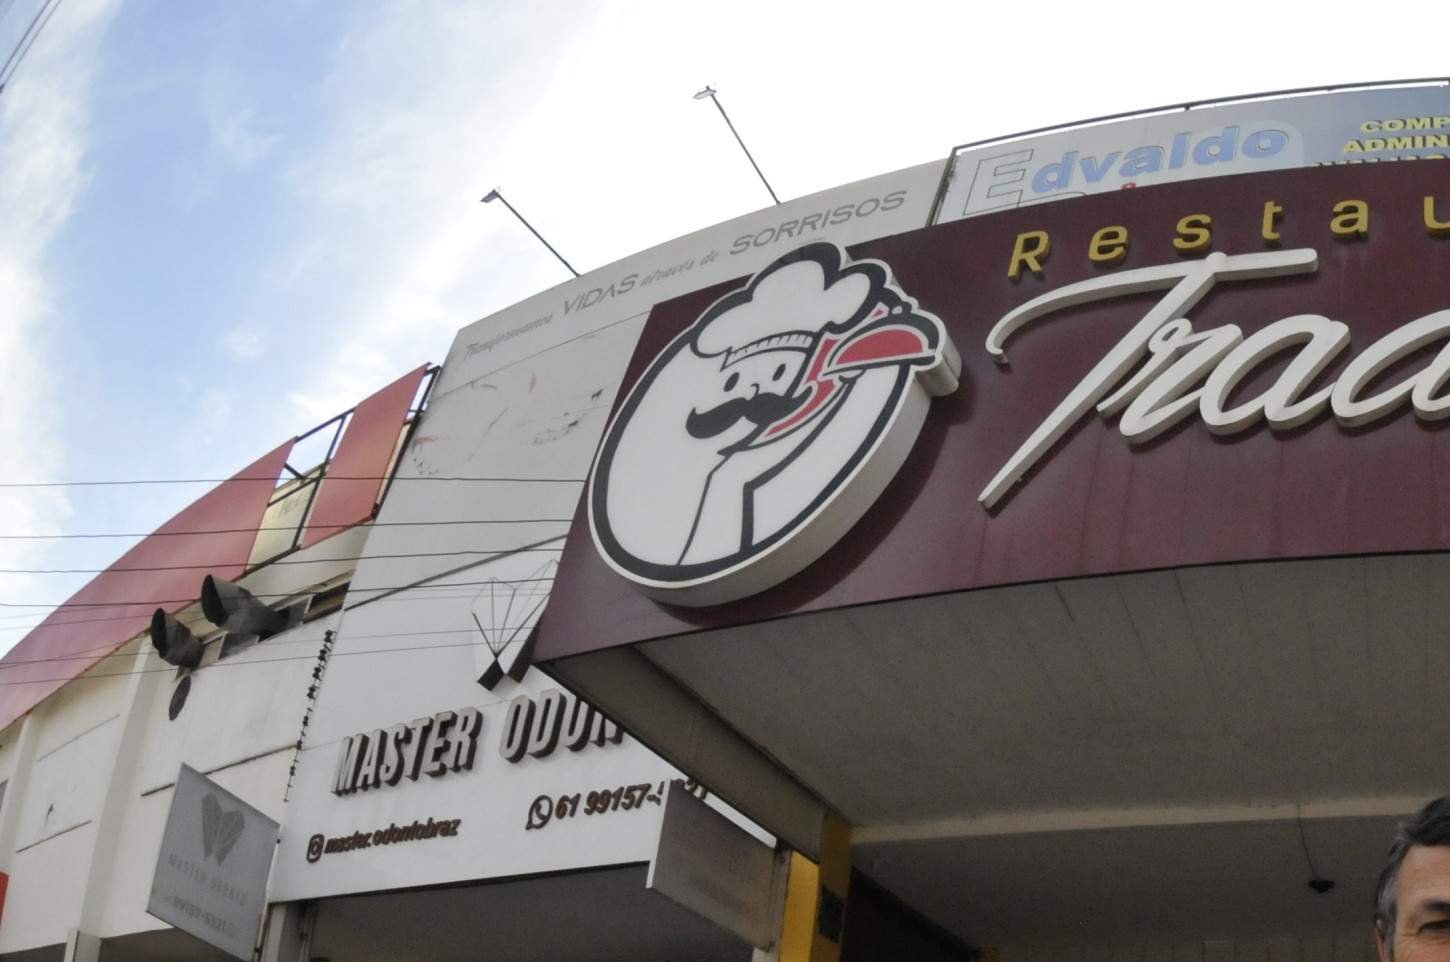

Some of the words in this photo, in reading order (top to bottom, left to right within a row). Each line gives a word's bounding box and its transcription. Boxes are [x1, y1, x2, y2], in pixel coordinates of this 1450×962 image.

[962, 125, 1290, 217] Edvaldo
[563, 273, 640, 317] VIDAS
[729, 190, 908, 257] SORRISOS
[331, 706, 484, 797] MASTER
[554, 792, 582, 820] 61
